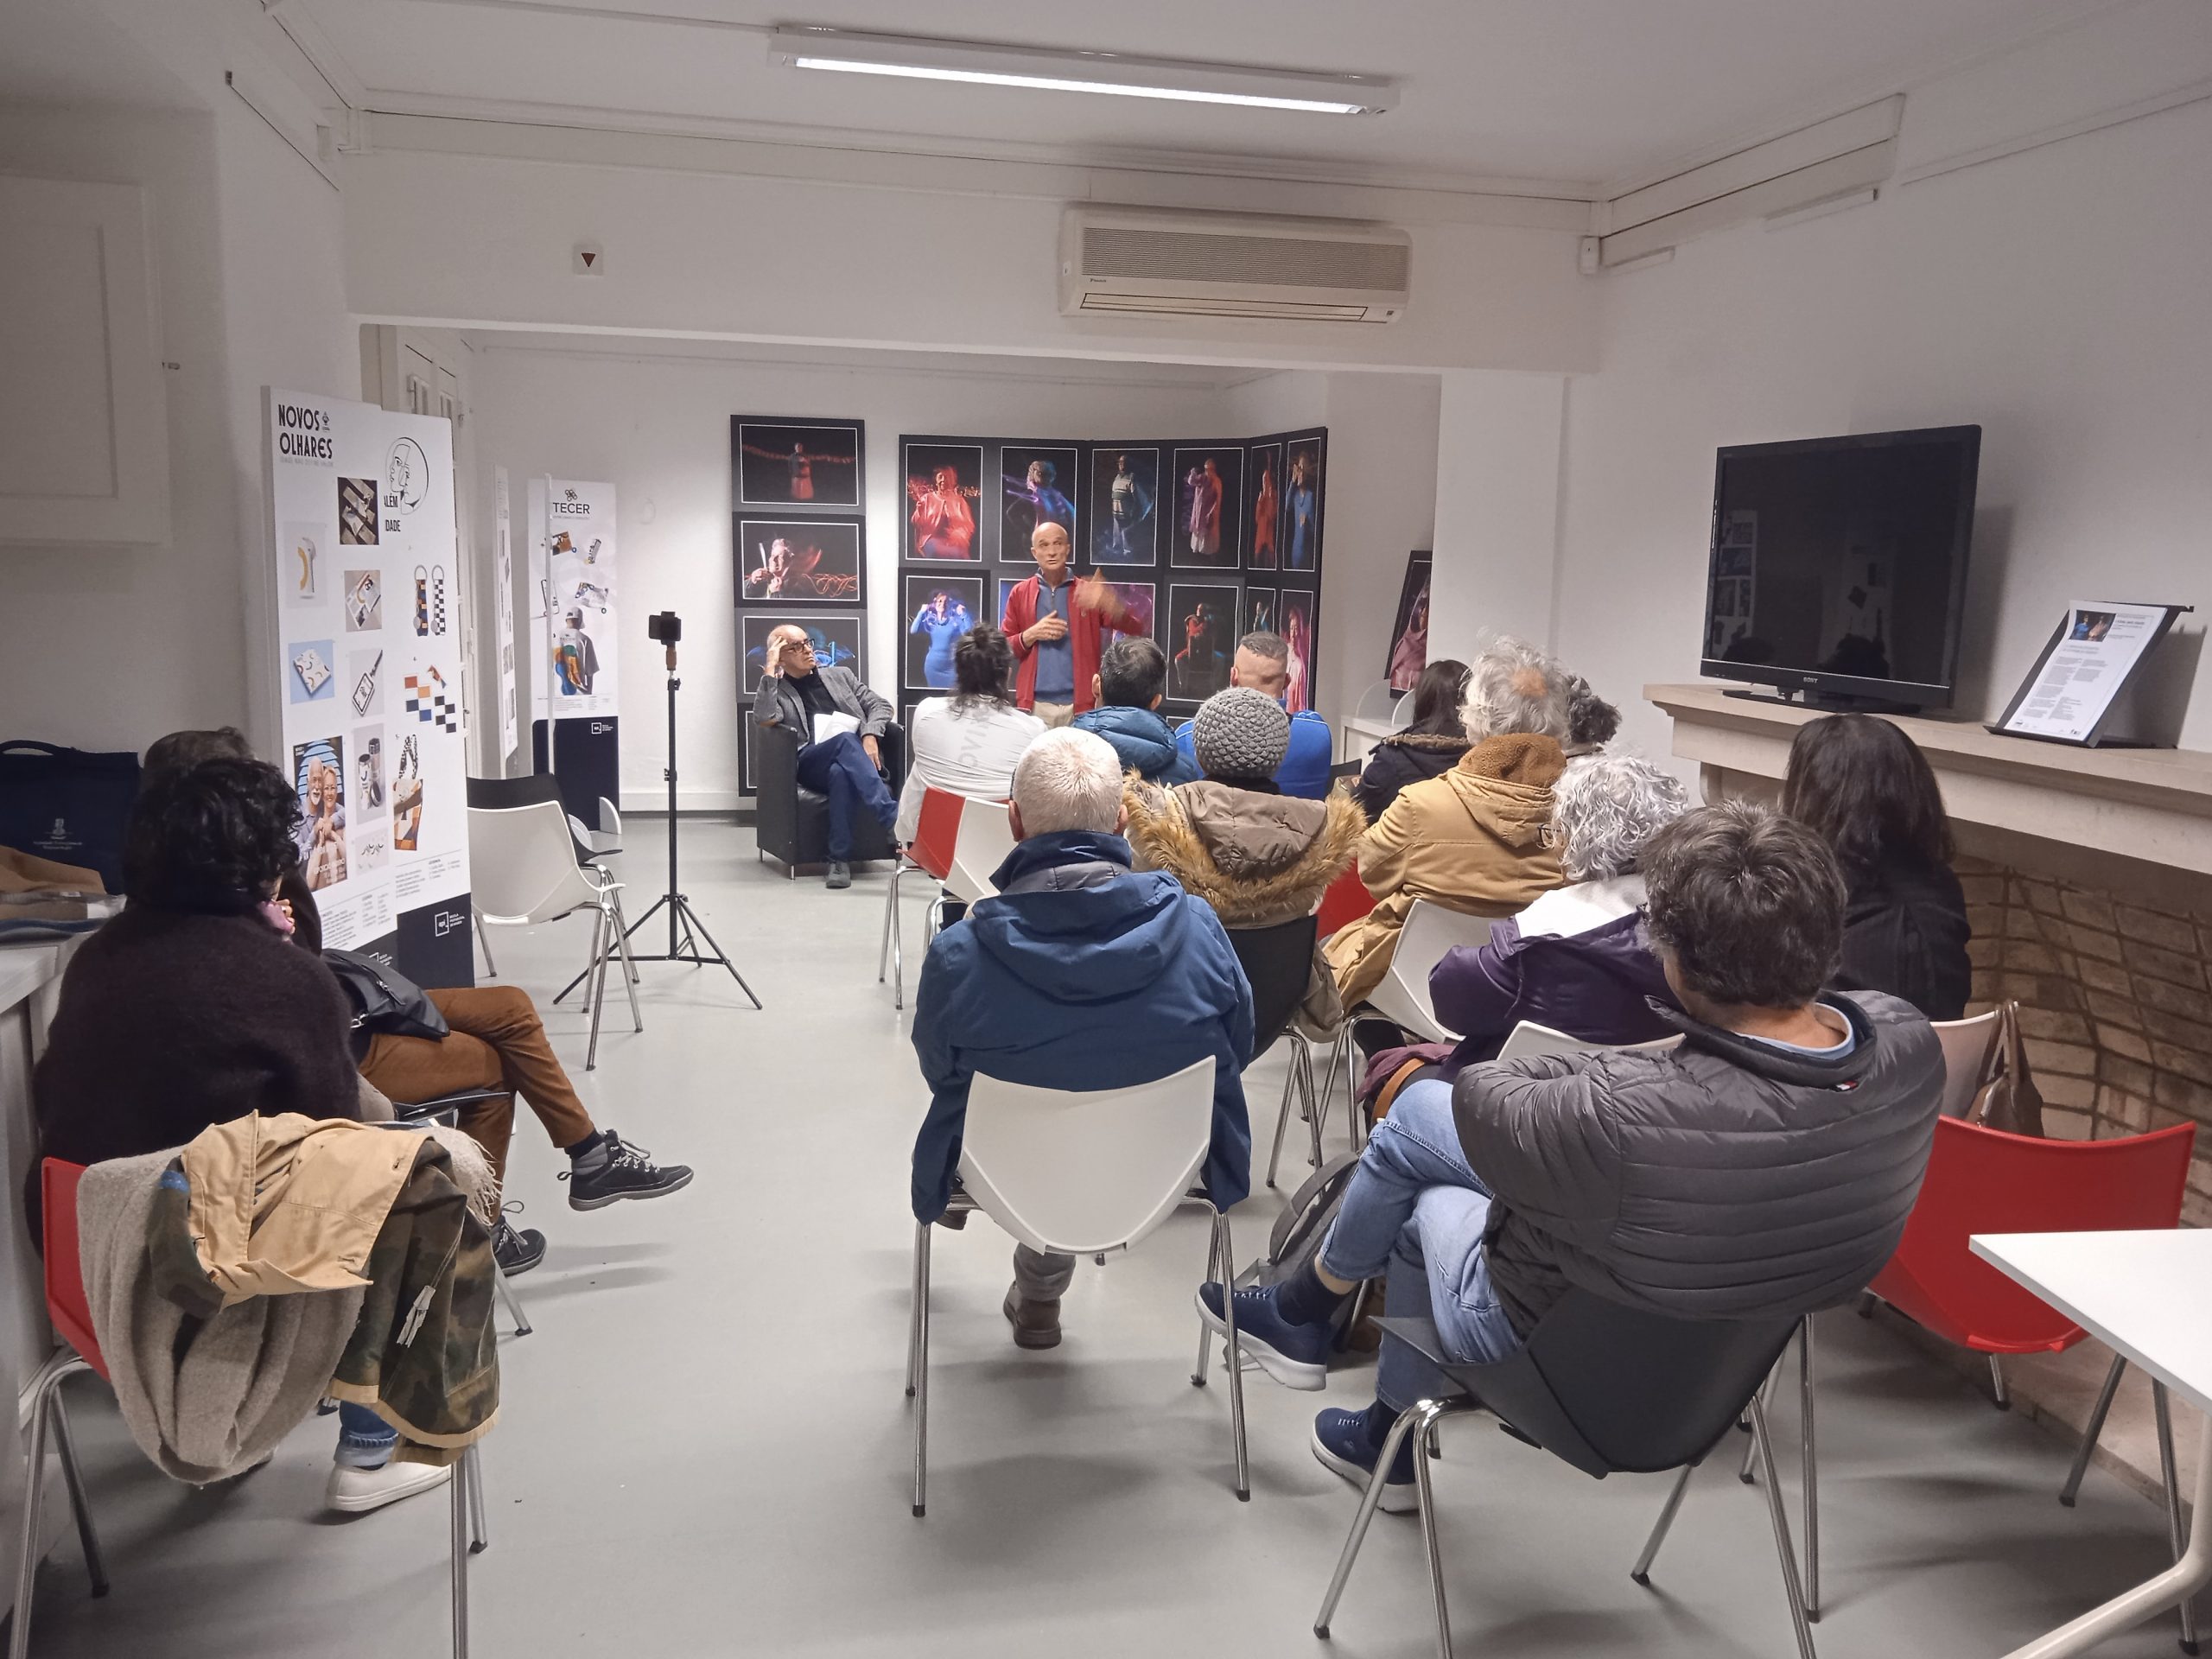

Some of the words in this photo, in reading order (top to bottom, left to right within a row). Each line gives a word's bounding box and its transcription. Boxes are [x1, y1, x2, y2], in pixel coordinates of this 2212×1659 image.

[278, 404, 320, 431] NOVOS
[279, 432, 333, 459] OLHARES
[552, 502, 590, 514] TECER
[385, 519, 401, 531] DADE
